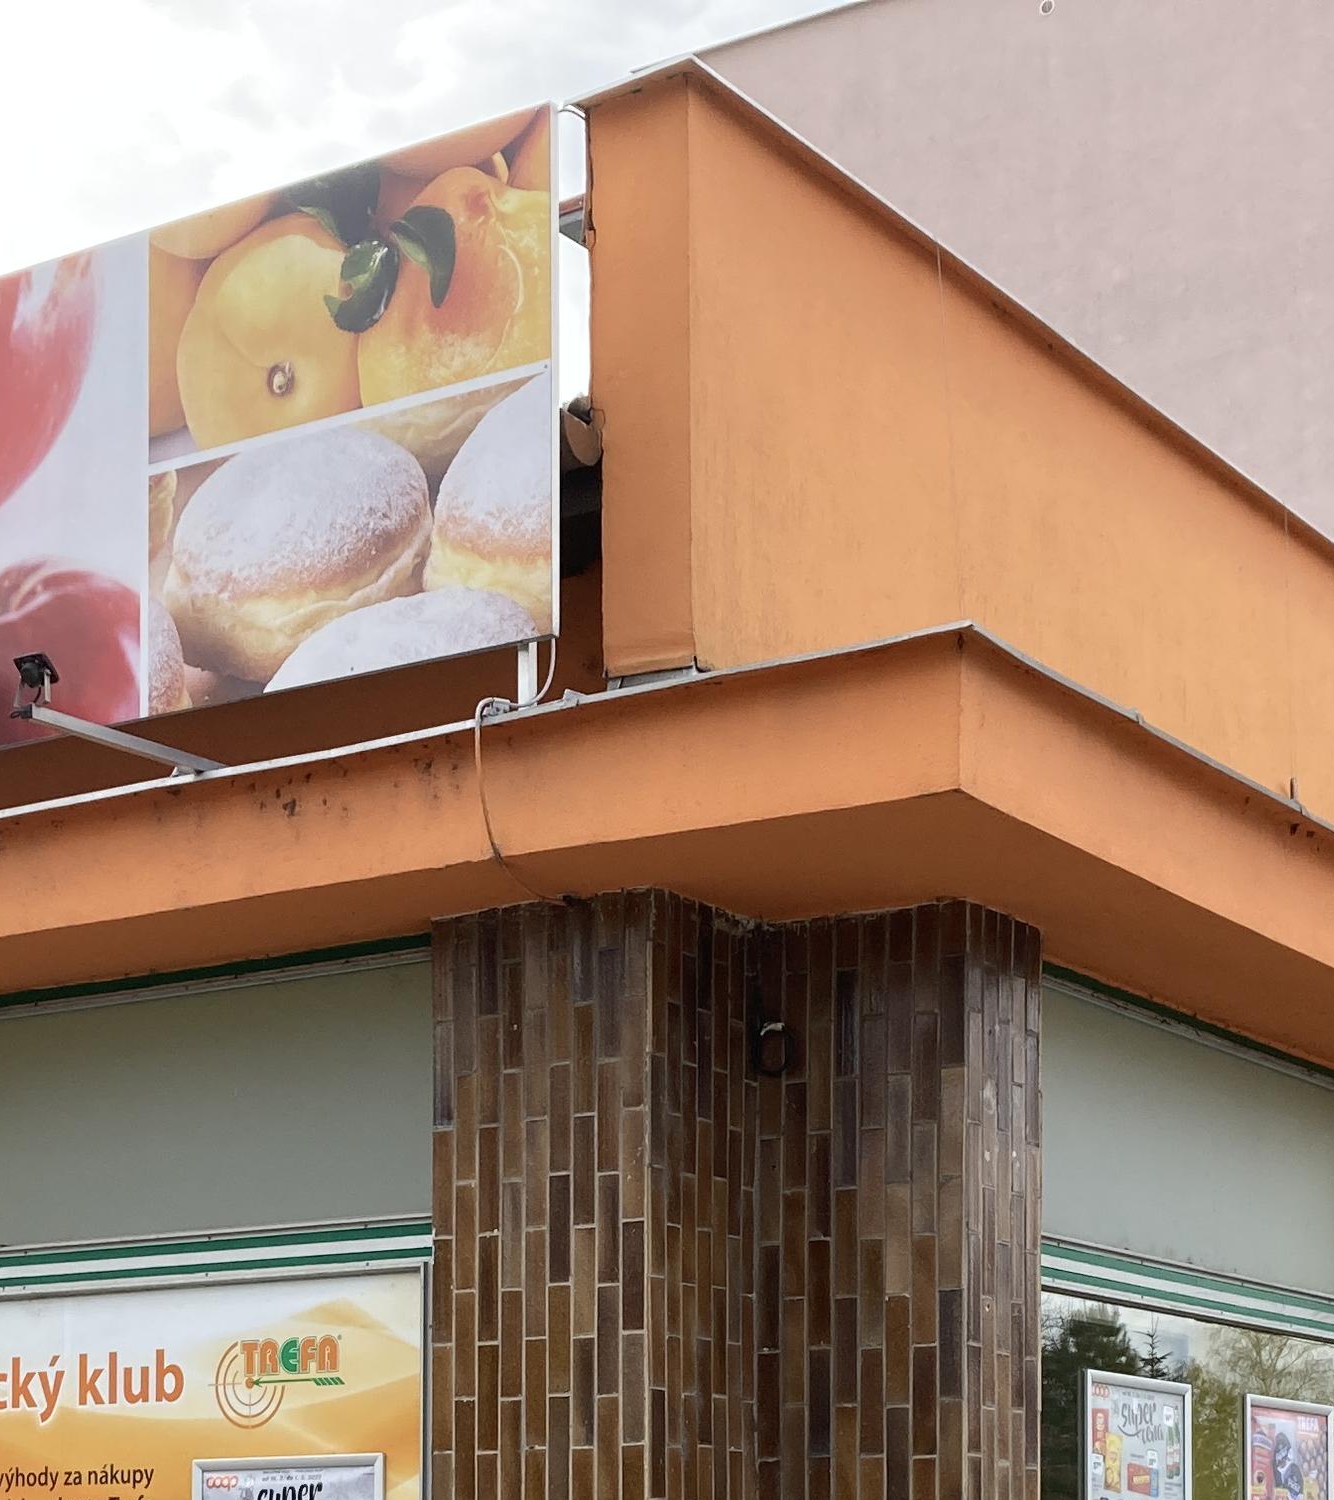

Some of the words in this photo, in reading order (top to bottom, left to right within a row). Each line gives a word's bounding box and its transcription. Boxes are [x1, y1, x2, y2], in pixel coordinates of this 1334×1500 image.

[240, 1334, 341, 1376] TREFA
[78, 1348, 185, 1407] klub
[63, 1471, 82, 1486] za
[87, 1464, 154, 1489] nákupy
